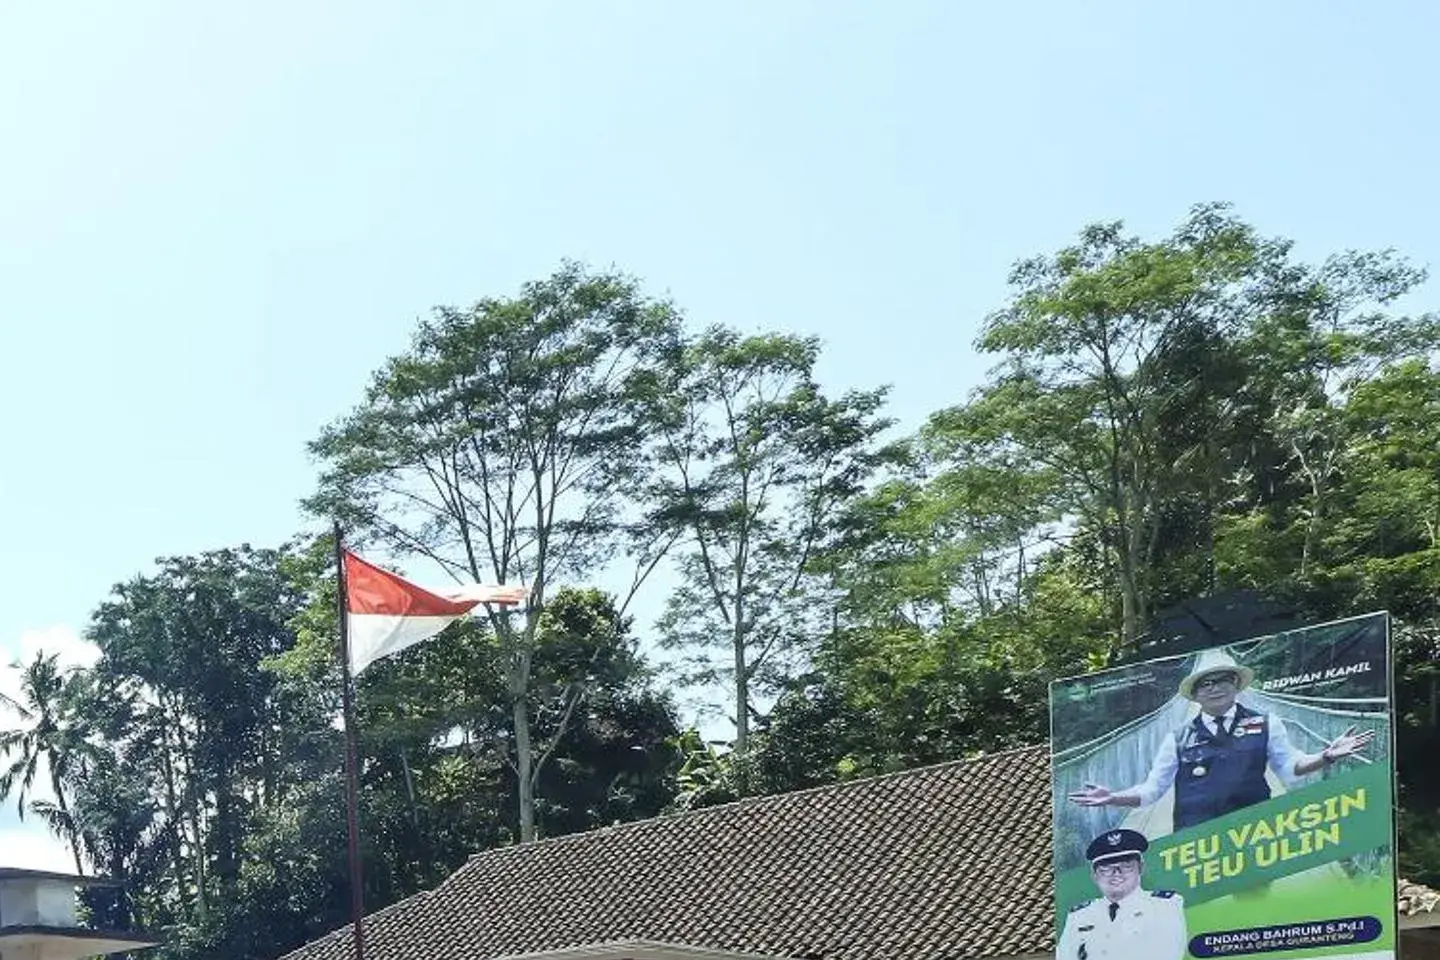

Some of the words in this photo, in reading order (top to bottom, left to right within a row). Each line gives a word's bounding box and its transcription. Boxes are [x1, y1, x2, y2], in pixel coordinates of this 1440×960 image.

[1262, 671, 1322, 690] RIDWAN
[1324, 661, 1371, 679] KAMIL
[1160, 834, 1220, 872] TEU
[1228, 788, 1366, 849] VAKSIN
[1182, 852, 1244, 889] TEU
[1255, 823, 1340, 868] ULIN
[1205, 931, 1260, 946] ENDANG
[1263, 925, 1322, 940] BAHRUM
